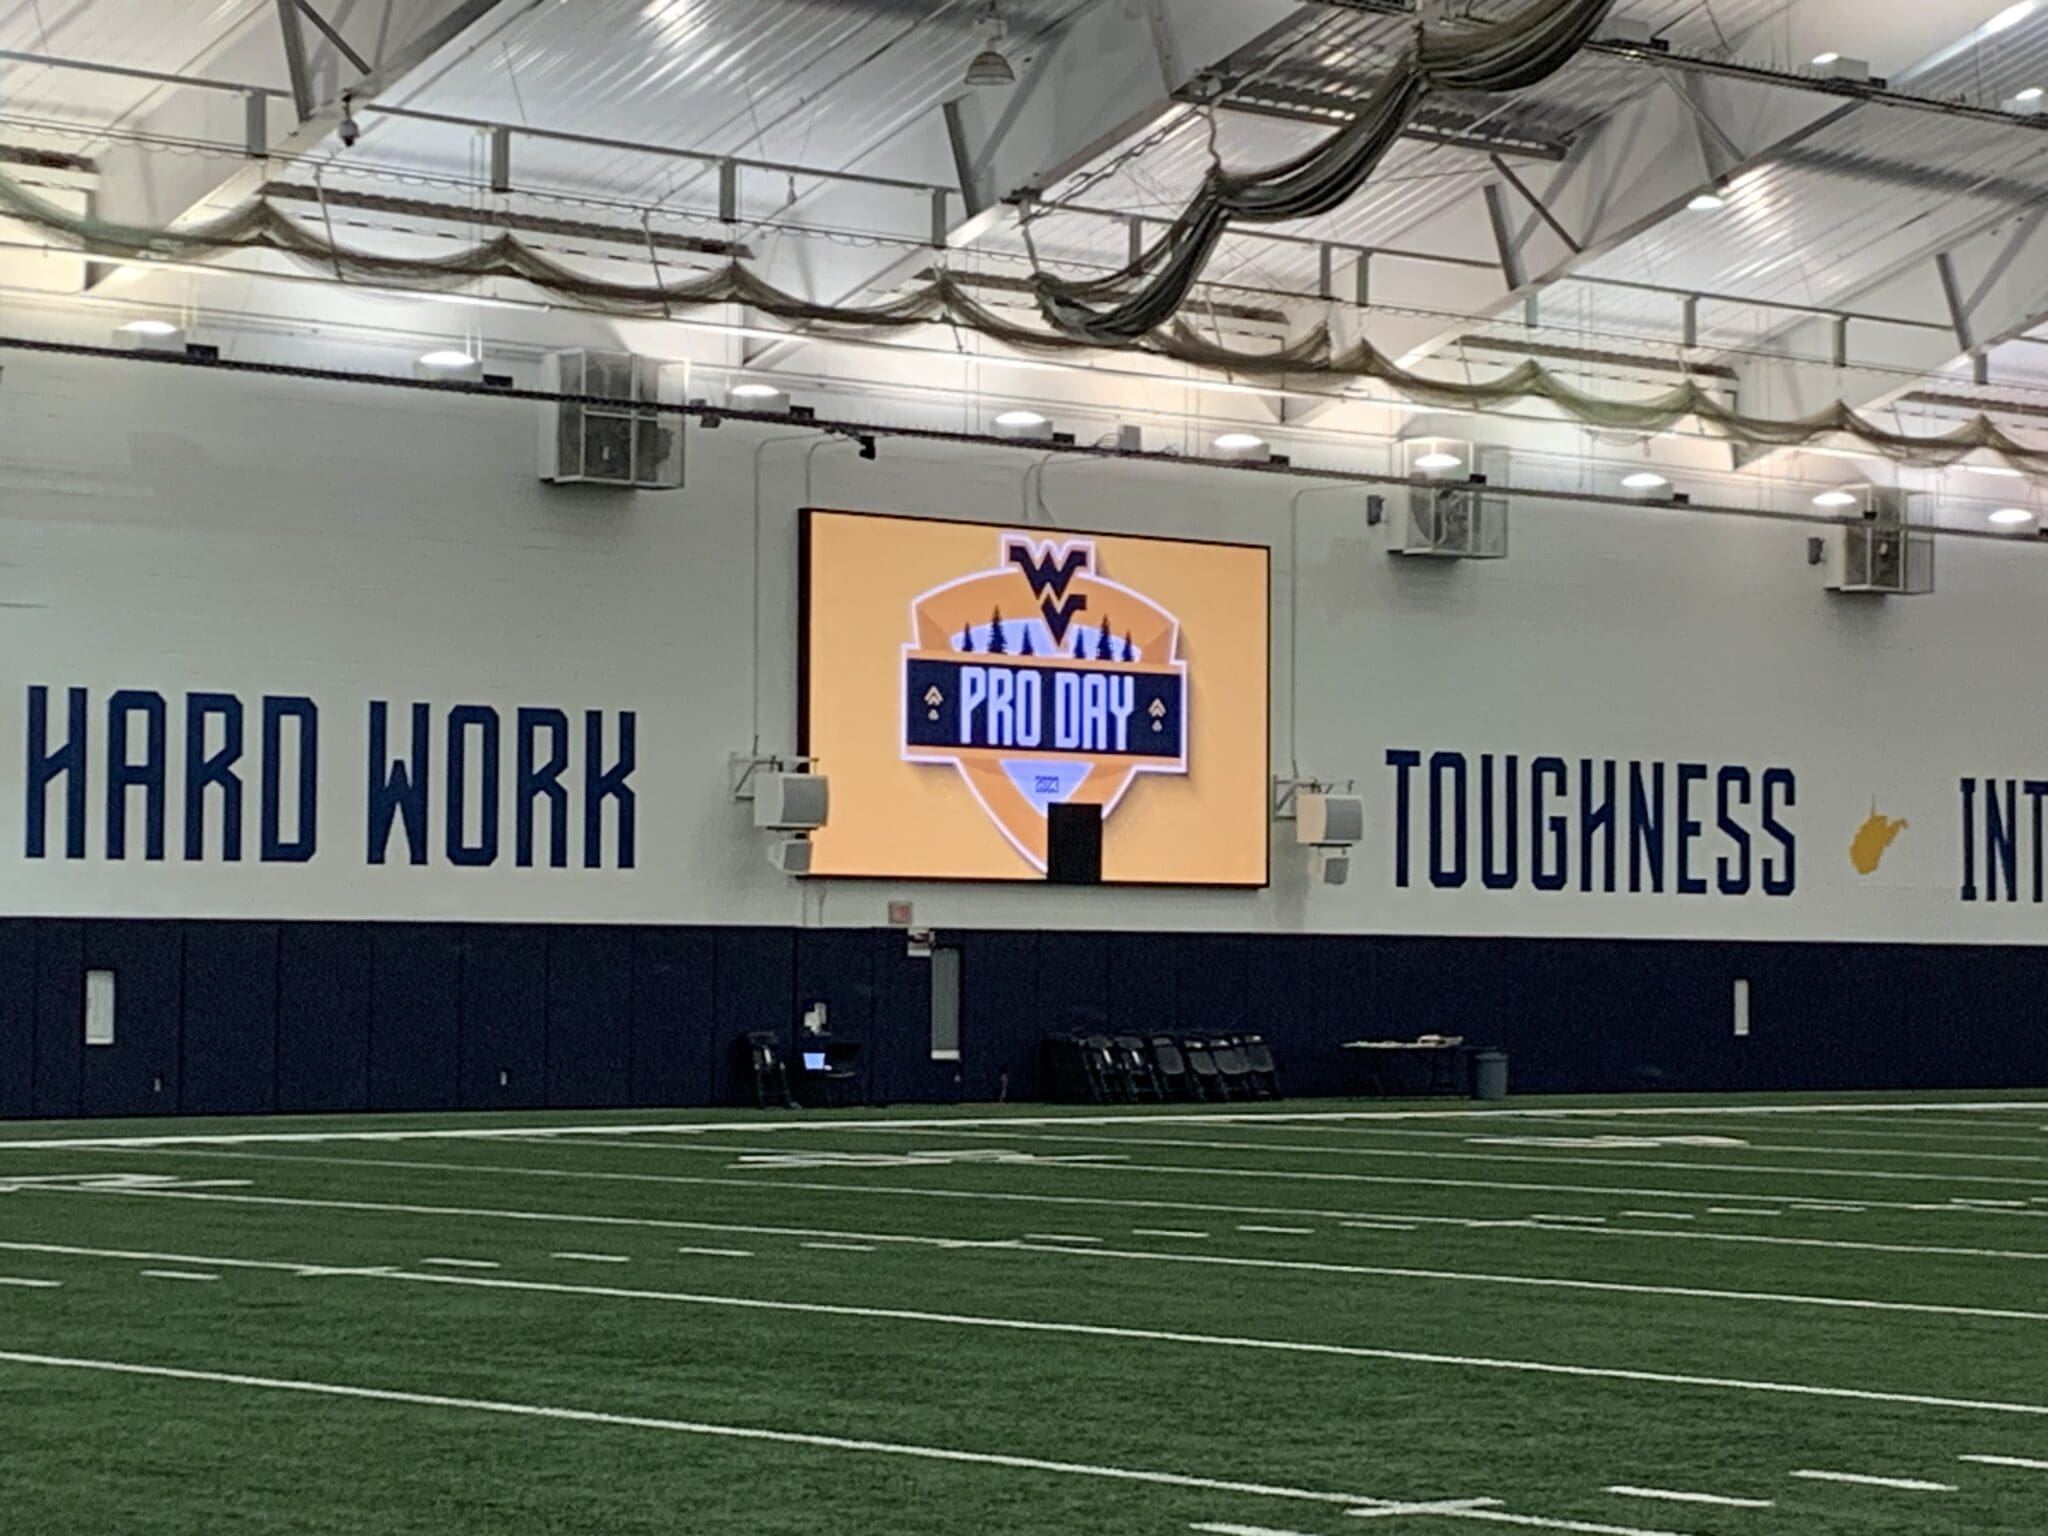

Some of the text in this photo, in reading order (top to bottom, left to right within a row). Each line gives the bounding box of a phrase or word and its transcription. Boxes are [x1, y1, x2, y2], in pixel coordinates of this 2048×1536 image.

[25, 685, 637, 870] HARD WORK
[960, 666, 1136, 752] PRO DAY
[1385, 748, 1796, 897] TOUGHNESS
[1959, 777, 2048, 904] INT
